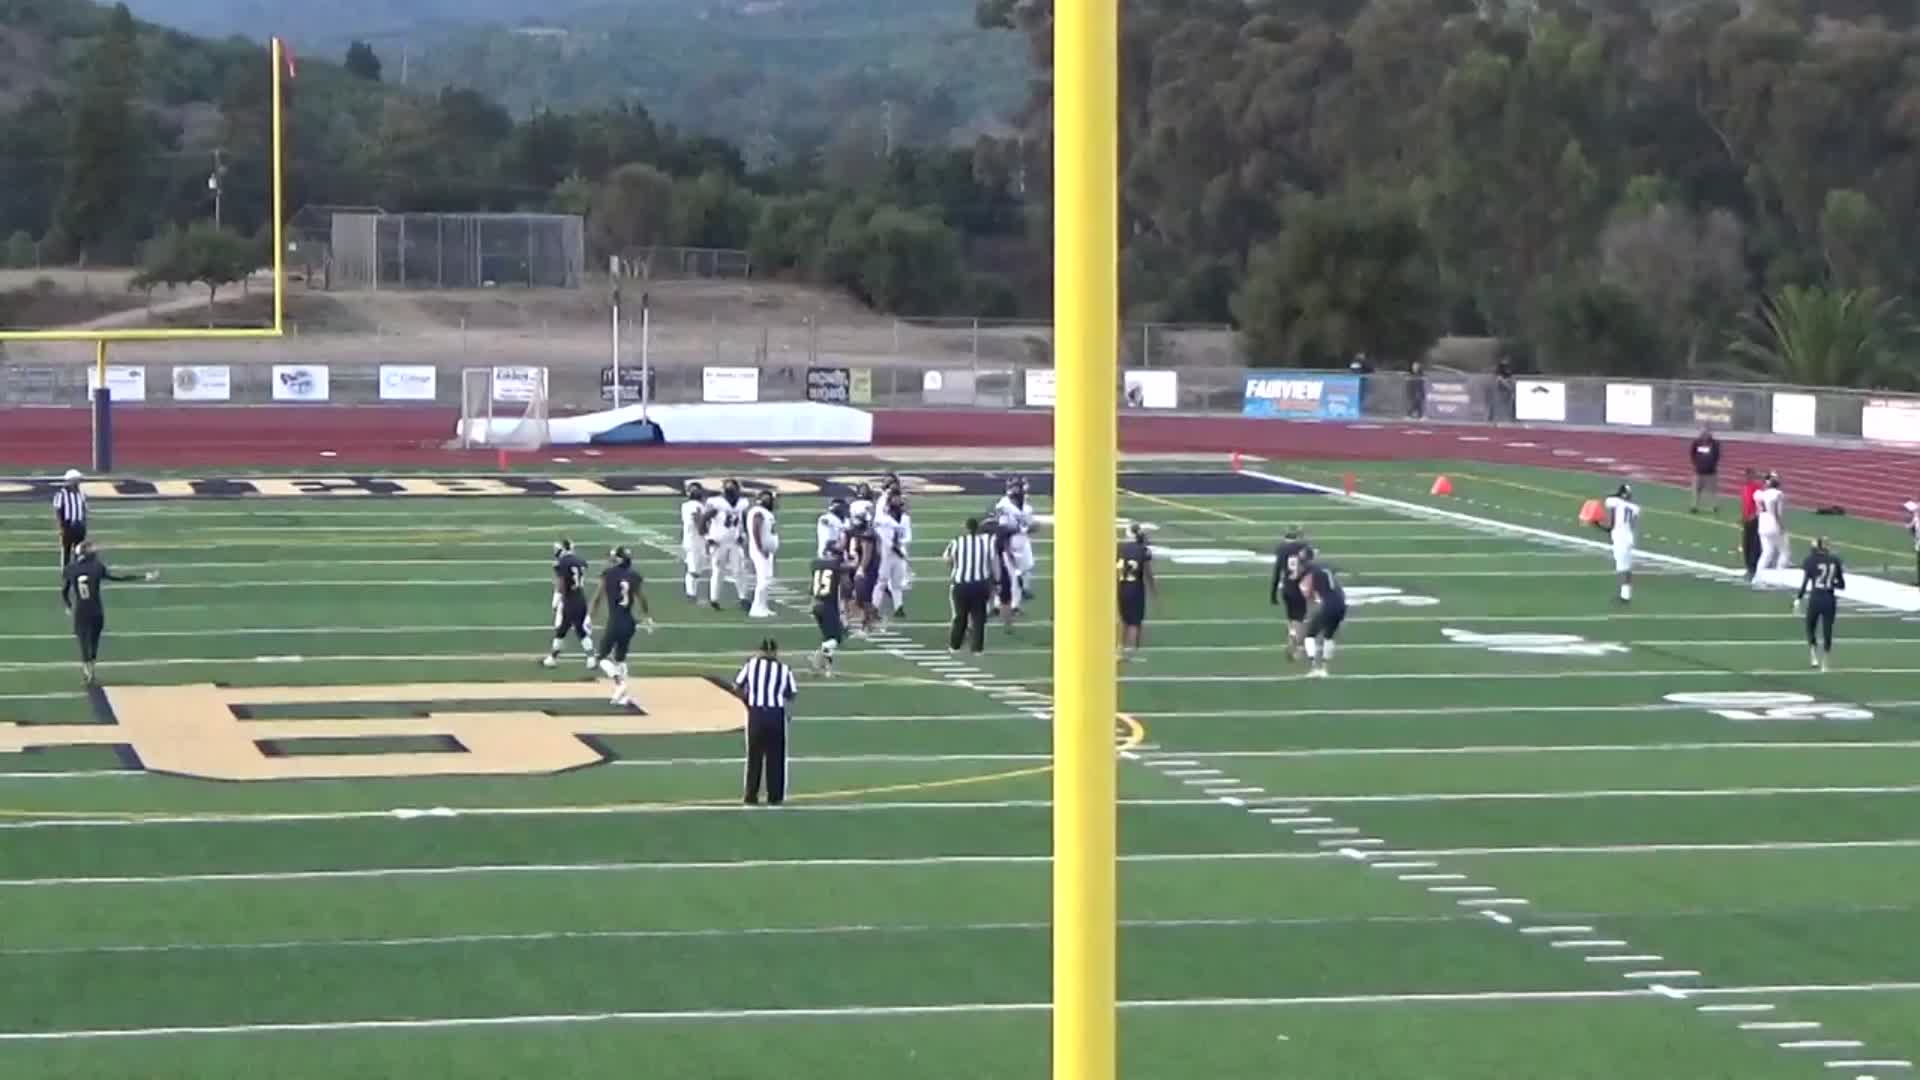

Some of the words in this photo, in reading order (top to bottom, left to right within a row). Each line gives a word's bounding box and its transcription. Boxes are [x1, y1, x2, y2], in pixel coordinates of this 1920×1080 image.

[1246, 379, 1325, 400] FAIRVIEW
[77, 575, 90, 600] 6
[618, 581, 630, 607] 3
[813, 569, 833, 597] 15
